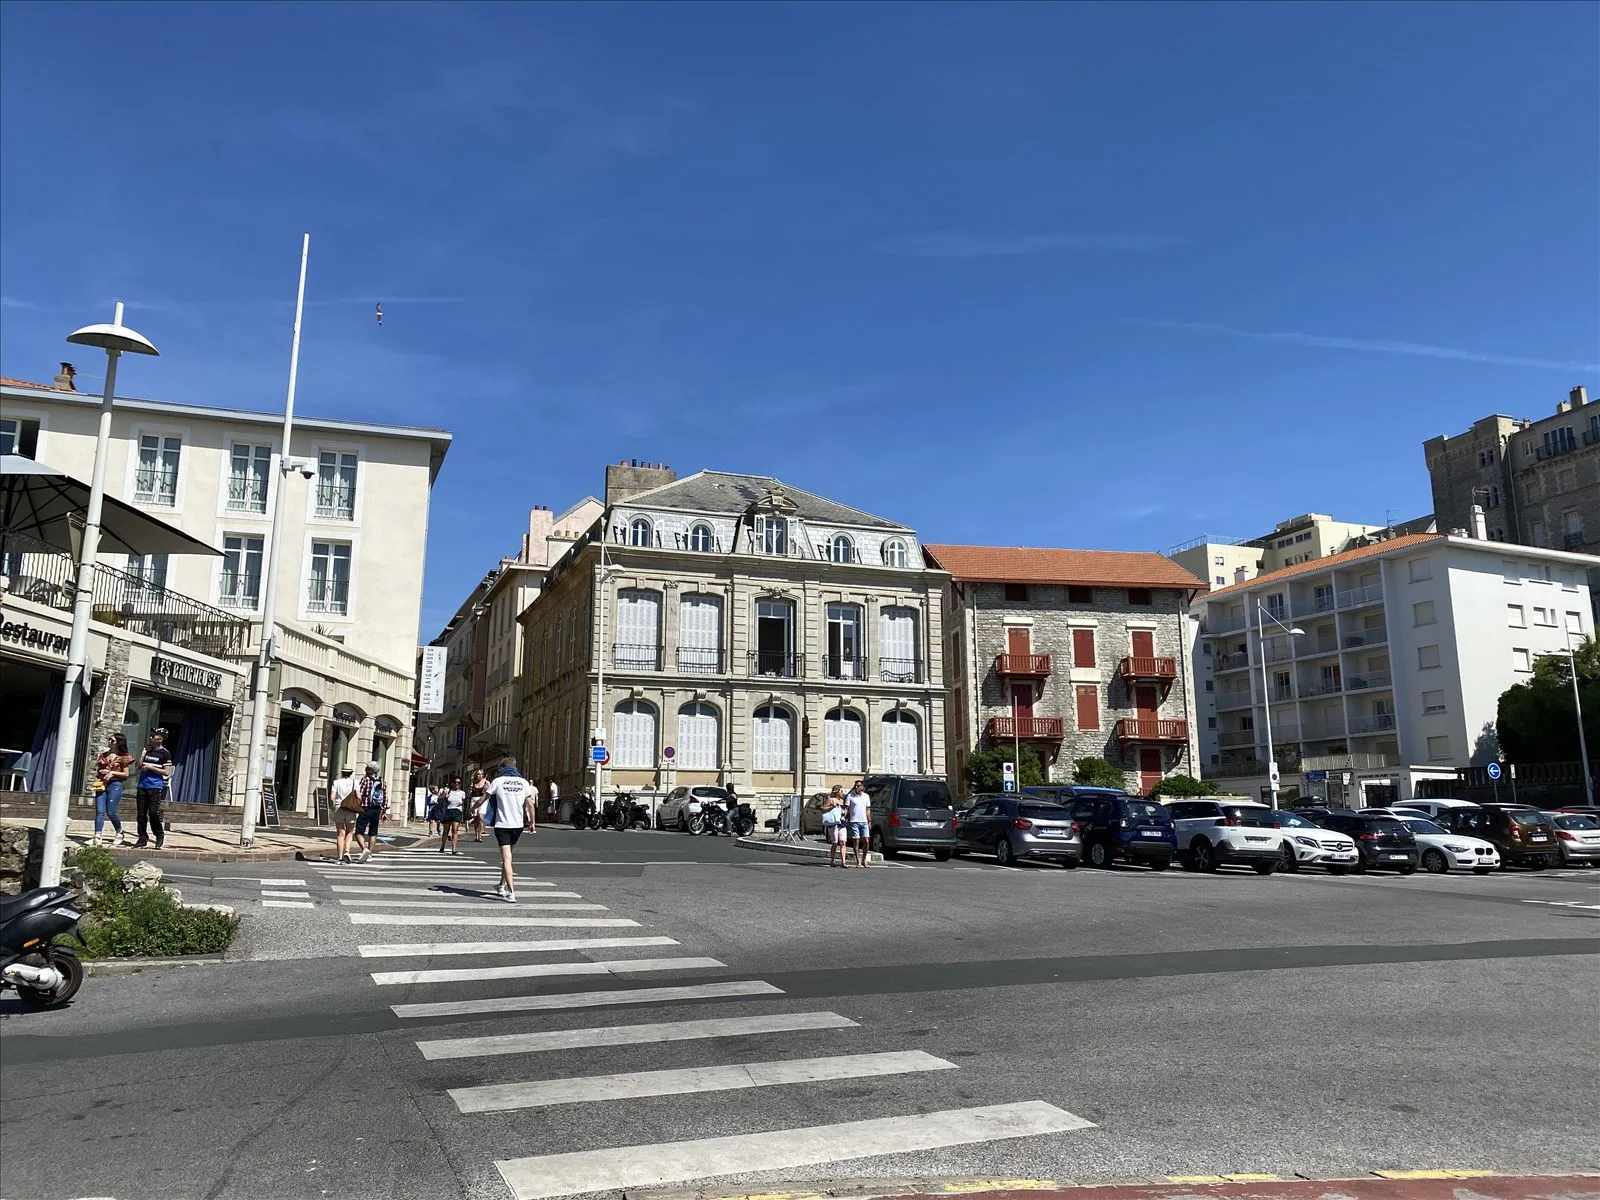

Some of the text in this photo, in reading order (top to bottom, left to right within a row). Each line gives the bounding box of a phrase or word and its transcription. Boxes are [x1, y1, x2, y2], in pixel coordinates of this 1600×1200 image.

[0, 612, 71, 651] estauran
[172, 661, 222, 689] BAIGNEUSES
[424, 648, 434, 689] BAIGNEUSES
